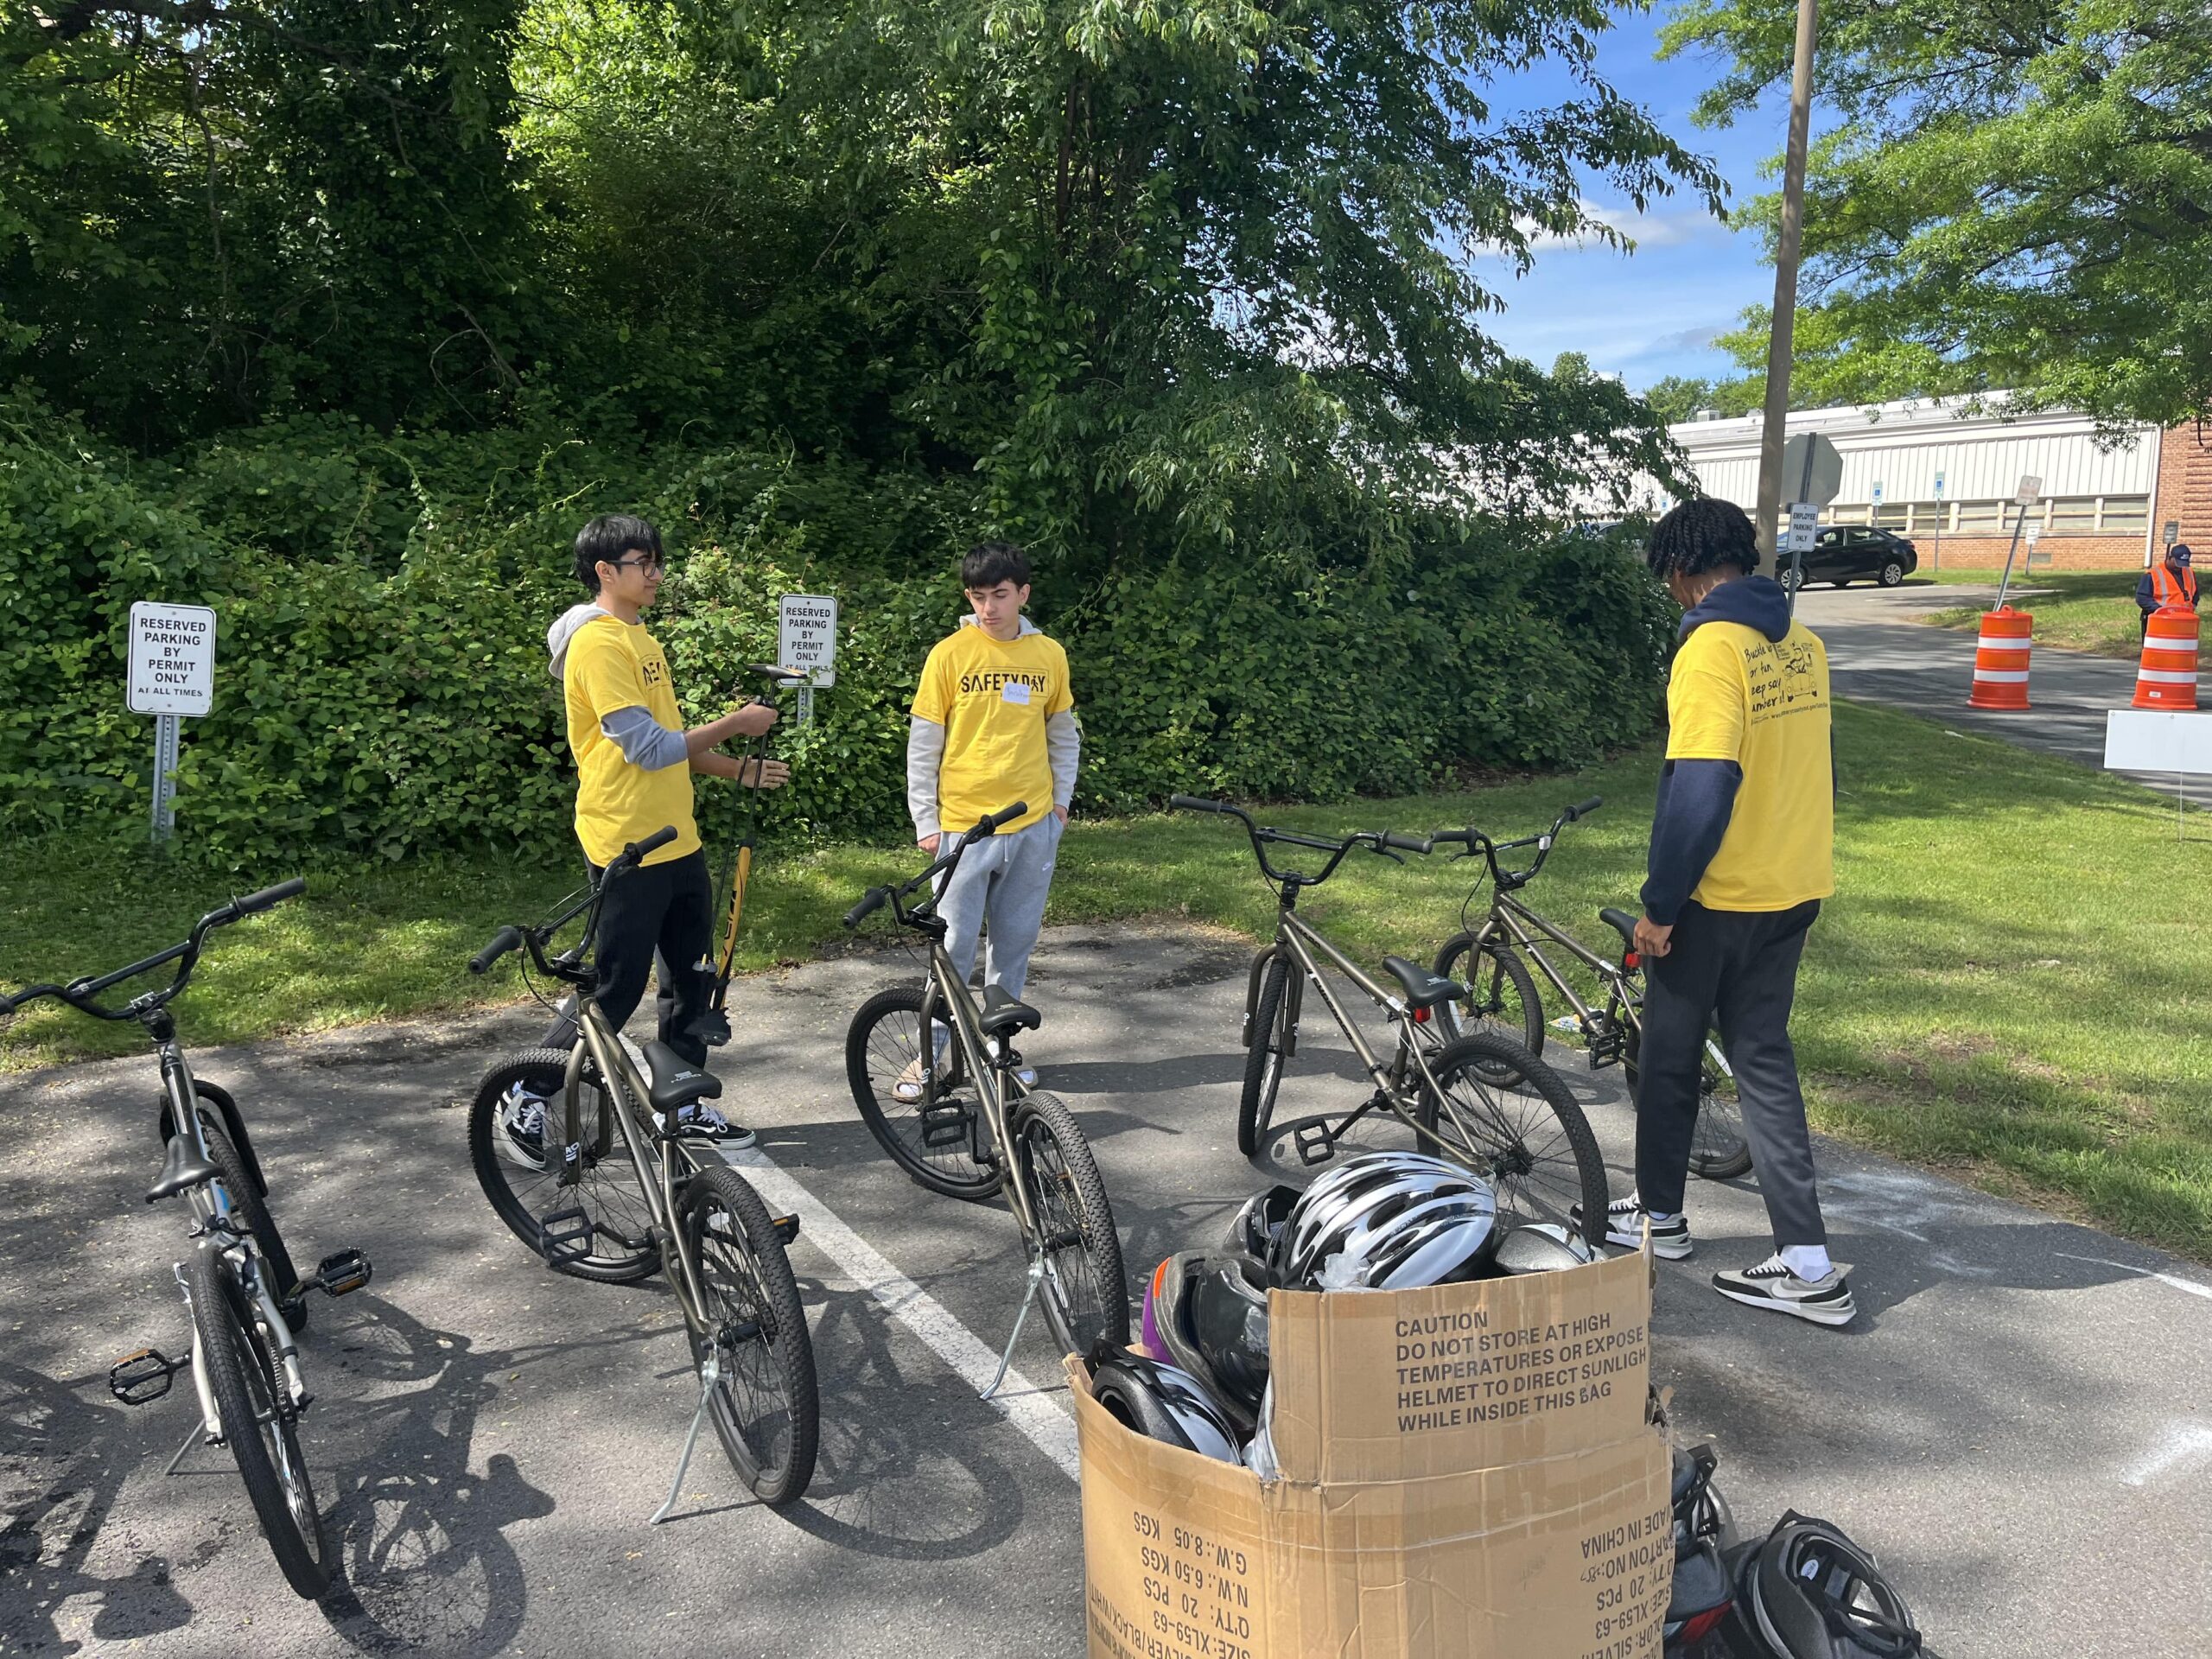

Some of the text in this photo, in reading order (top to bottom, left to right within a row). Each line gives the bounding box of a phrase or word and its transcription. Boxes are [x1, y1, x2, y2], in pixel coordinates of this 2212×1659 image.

[786, 607, 830, 617] RESERVED
[140, 618, 207, 632] RESERVED
[789, 619, 827, 629] PARKING
[802, 631, 814, 639] BY
[144, 632, 200, 645] PARKING
[791, 641, 823, 651] PERMIT
[163, 646, 181, 657] BY
[796, 652, 819, 661] ONLY
[1744, 642, 1766, 663] Buckle
[149, 658, 195, 671] PERMIT
[156, 672, 188, 683] ONLY
[961, 673, 1020, 692] SAFETY
[174, 689, 203, 697] TIMES
[1395, 1312, 1488, 1338] CAUTION
[1396, 1313, 1611, 1362] DO NOT STORE AT HIGH
[1396, 1325, 1643, 1385] TEMPERATURES OR EXPOSE
[1398, 1346, 1646, 1409] HELMET TO DIRECT SUNLIGH
[1397, 1381, 1611, 1433] WHILE INSIDE THIS BAG
[1628, 1519, 1642, 1542] IN
[1134, 1511, 1247, 1575] G.W.: 8.05 KGS
[1580, 1527, 1624, 1559] CHINA
[1141, 1546, 1249, 1608] N.W.: 6.50 KGS
[1601, 1554, 1625, 1580] NO:
[1597, 1558, 1674, 1611] Q'TY: 20 PCS
[1143, 1576, 1249, 1639] Q'TY: 20 PCS
[1596, 1582, 1672, 1640] SIZE: XL59-63
[1154, 1610, 1211, 1655] XL59-63
[1636, 1613, 1663, 1648] OLOR:
[1213, 1637, 1250, 1659] SIZE:
